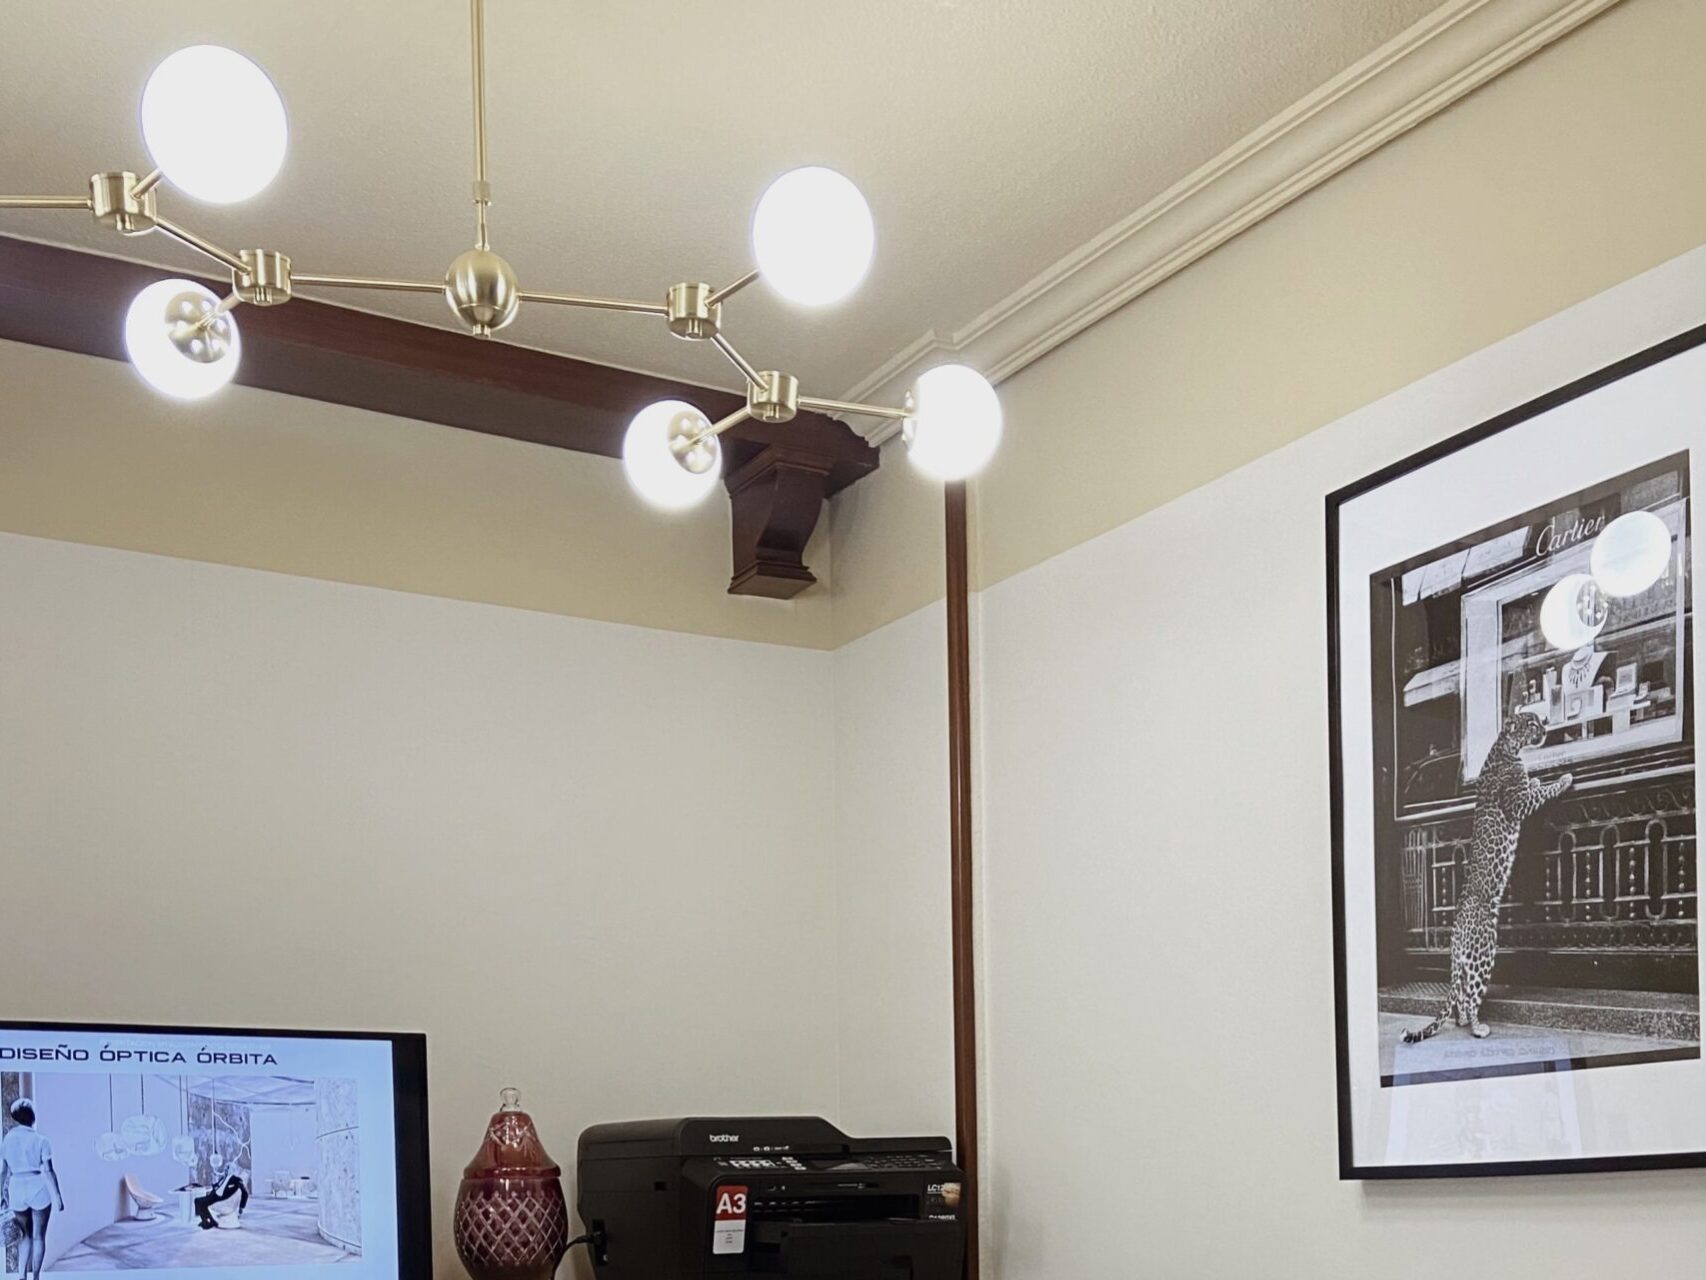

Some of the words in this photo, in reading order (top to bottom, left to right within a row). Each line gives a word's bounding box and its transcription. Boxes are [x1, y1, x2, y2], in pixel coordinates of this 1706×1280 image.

[1536, 515, 1605, 556] Cartier
[0, 1044, 89, 1061] DISEÑO
[100, 1042, 187, 1063] ÓPTICA
[197, 1044, 278, 1065] ÓRBITA
[709, 1134, 740, 1143] brother
[716, 1193, 747, 1215] A3
